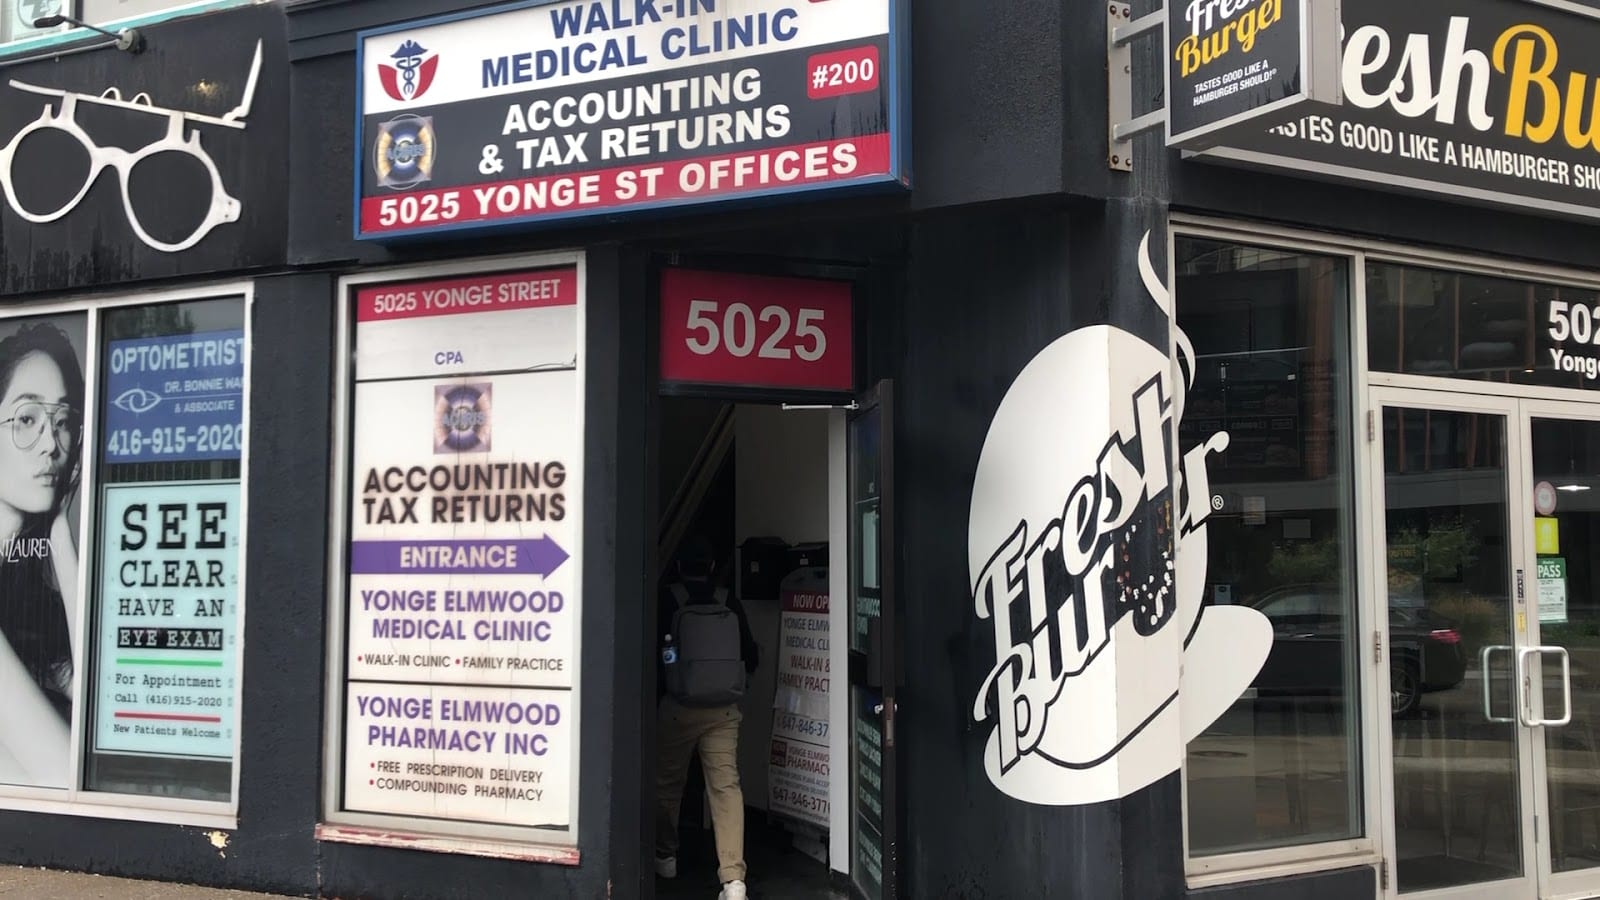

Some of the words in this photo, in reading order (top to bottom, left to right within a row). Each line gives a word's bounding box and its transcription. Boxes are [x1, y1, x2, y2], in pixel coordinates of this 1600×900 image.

[482, 36, 648, 89] MEDICAL
[660, 7, 799, 61] CLINIC
[1175, 0, 1283, 78] Burger
[812, 58, 875, 89] #200
[1194, 76, 1222, 94] TASTES
[1222, 69, 1244, 84] GOOD
[1245, 62, 1261, 75] LIKE
[1262, 59, 1269, 69] A
[502, 68, 762, 136] ACCOUNTING
[1193, 83, 1239, 106] HAMBURGER
[478, 143, 504, 175] &
[516, 134, 589, 170] TAX
[600, 104, 792, 161] RETURNS
[1339, 121, 1393, 154] GOOD
[1399, 131, 1440, 163] LIKE
[1444, 140, 1458, 166] A
[1460, 143, 1570, 185] HAMBURGER
[379, 191, 460, 227] 5025
[472, 175, 601, 216] YONGE
[614, 168, 664, 201] ST
[679, 143, 858, 194] OFFICES
[373, 291, 417, 313] 5025
[422, 285, 492, 309] YONGE
[497, 278, 561, 303] STREET
[685, 300, 827, 361] 5025
[111, 338, 244, 374] OPTOMETRIST
[434, 351, 464, 365] CPA
[164, 381, 182, 393] DR.
[184, 378, 223, 392] BONNIE
[174, 403, 182, 414] &
[184, 400, 235, 413] ASSOCIATE
[108, 423, 243, 456] 416-915-2020
[363, 461, 566, 493] ACCOUNTING
[363, 497, 418, 524] TAX
[431, 493, 566, 523] RETURNS
[120, 502, 227, 551] SEE
[400, 545, 518, 568] ENTRANCE
[119, 560, 225, 588] CLEAR
[1537, 564, 1562, 578] PASS
[118, 599, 174, 617] HAVE
[194, 599, 225, 617] AN
[361, 590, 437, 612] YONGE
[444, 590, 564, 613] ELMWOOD
[793, 594, 814, 609] NOW
[372, 619, 466, 640] MEDICAL
[474, 620, 552, 642] CLINIC
[784, 617, 806, 631] YONGE
[118, 629, 158, 647] EYE
[166, 630, 222, 648] EXAM
[786, 636, 816, 651] MEDICAL
[364, 654, 410, 667] WALK-IN
[413, 655, 450, 668] CLINIC
[463, 656, 504, 669] FAMILY
[507, 657, 564, 671] PRACTICE
[791, 655, 823, 672] WALK-IN
[115, 673, 136, 685] For
[142, 674, 222, 689] Appointment
[779, 672, 803, 688] FAMILY
[115, 693, 137, 705] Call
[145, 694, 222, 708] (416)915-2020
[357, 696, 432, 720] YONGE
[440, 699, 561, 726] ELMWOOD
[113, 724, 130, 734] New
[134, 725, 178, 737] Patients
[181, 727, 222, 739] Welcome
[368, 725, 497, 753] PHARMACY
[504, 733, 549, 756] INC
[377, 760, 401, 774] FREE
[407, 762, 484, 780] PRESCRIPTION
[490, 768, 543, 784] DELIVERY
[786, 756, 830, 777] PHARMACY
[376, 777, 467, 796] COMPOUNDING
[474, 785, 543, 802] PHARMACY
